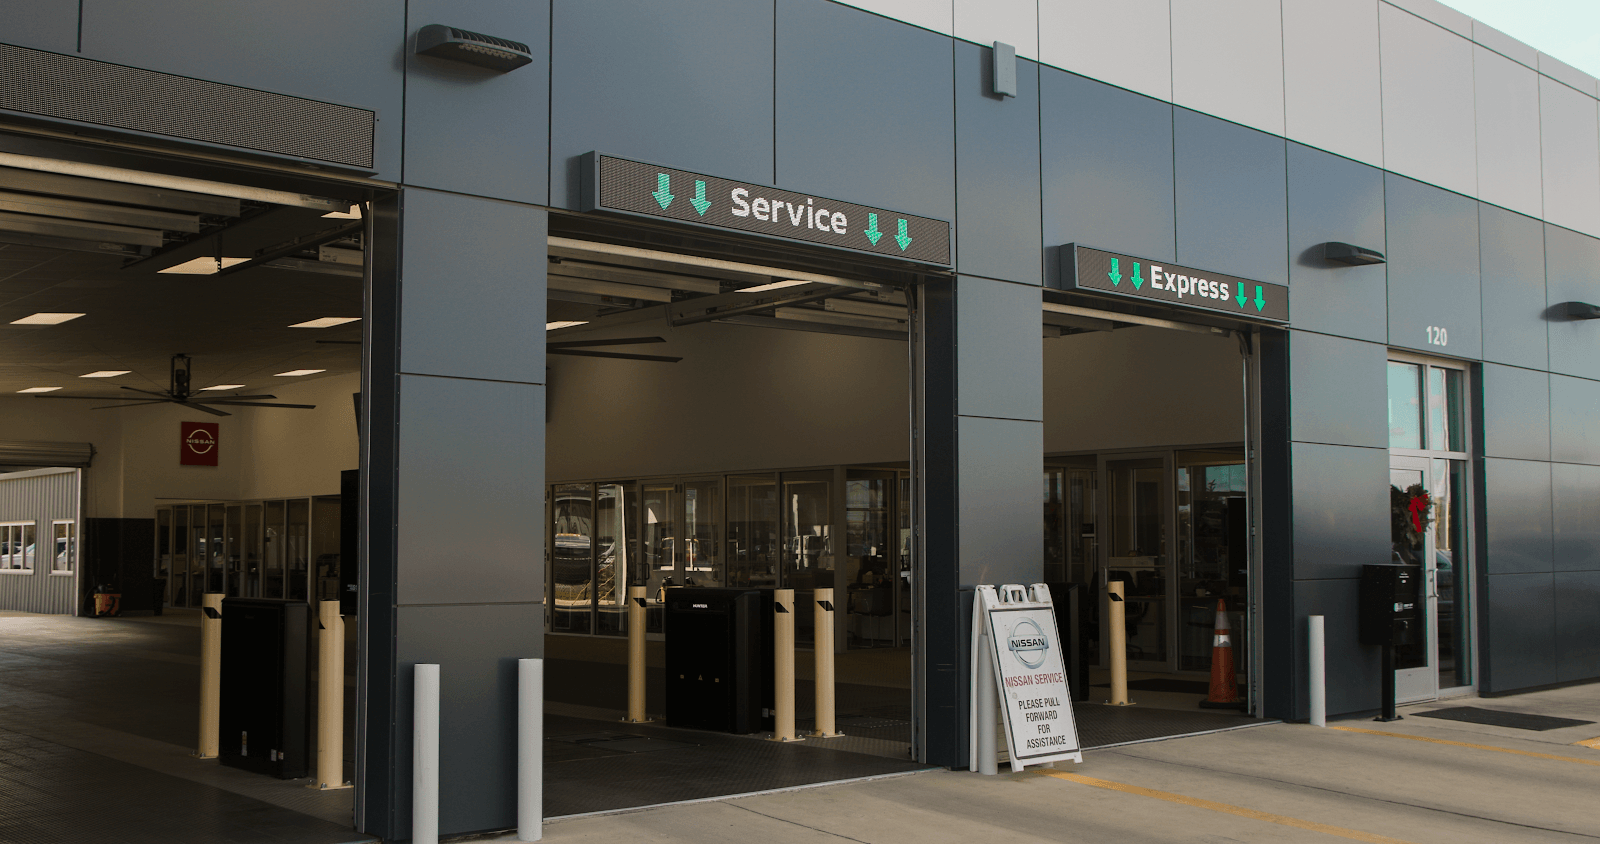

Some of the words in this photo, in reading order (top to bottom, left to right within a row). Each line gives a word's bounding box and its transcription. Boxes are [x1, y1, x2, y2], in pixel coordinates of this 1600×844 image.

[731, 187, 848, 235] Service
[1150, 264, 1230, 301] Express
[1425, 325, 1448, 347] 120
[1011, 638, 1045, 648] NISSAN
[1005, 674, 1034, 688] NISSAN
[1034, 672, 1063, 686] SERVICE
[1018, 698, 1044, 710] PLEASE
[1044, 697, 1060, 708] PULL
[1026, 710, 1058, 722] FORWARD
[1037, 724, 1051, 735] FOR
[1026, 735, 1066, 749] ASSISTANCE
